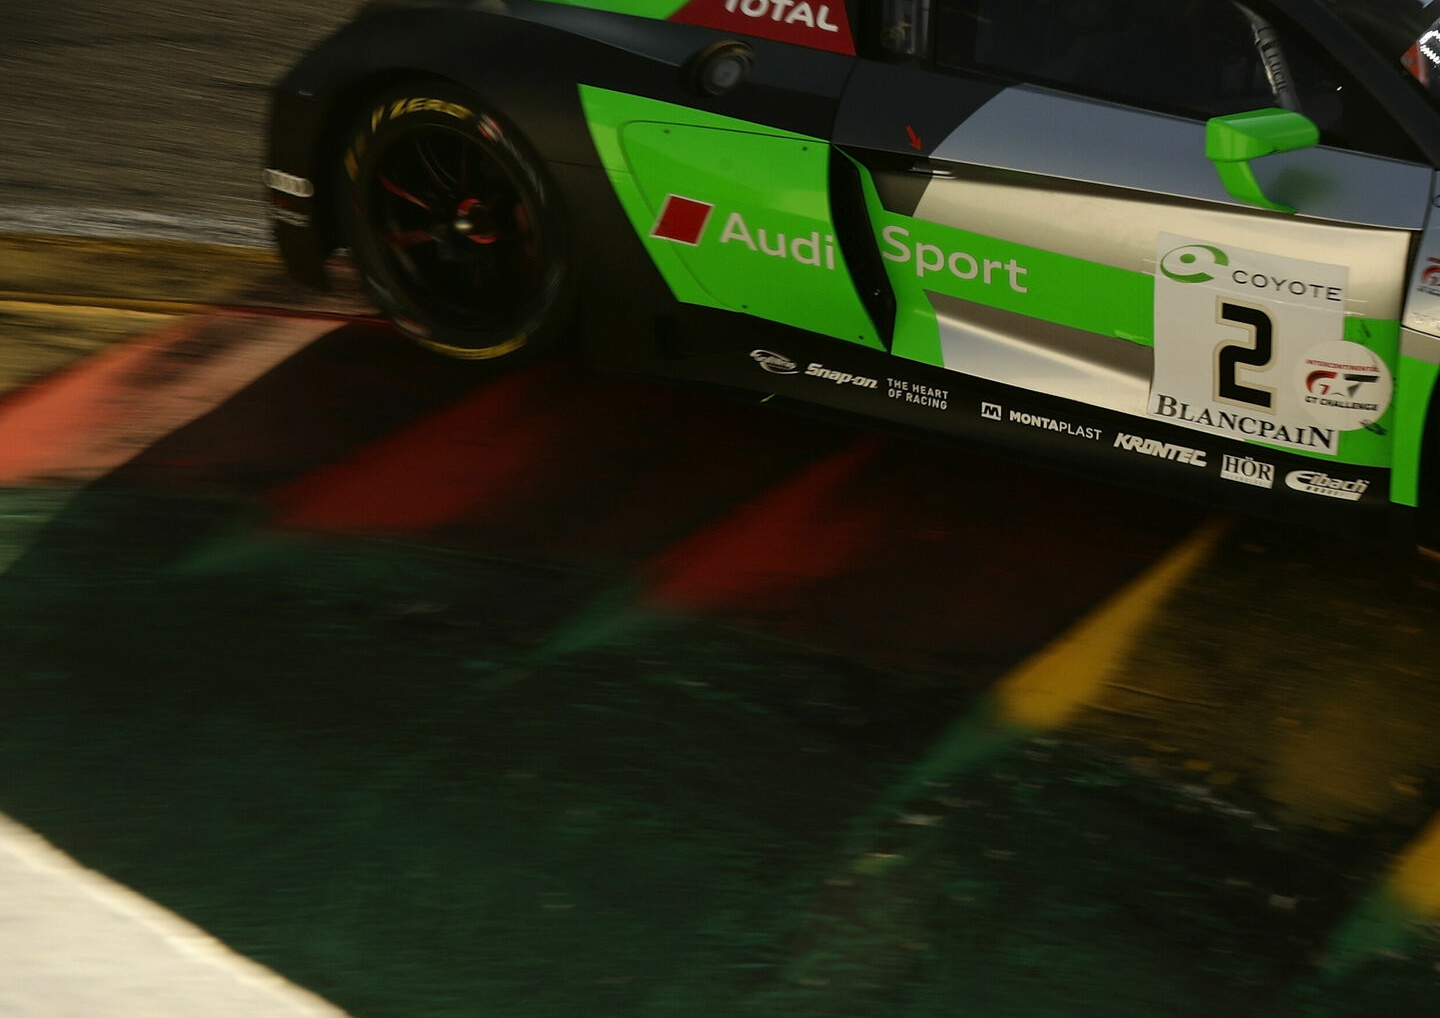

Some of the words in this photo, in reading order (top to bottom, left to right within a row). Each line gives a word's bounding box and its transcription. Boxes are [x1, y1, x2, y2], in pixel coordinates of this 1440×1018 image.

[719, 212, 835, 271] Audi
[882, 225, 1028, 294] Sport
[1232, 269, 1342, 302] COYOTE
[1217, 300, 1274, 411] 2
[804, 362, 879, 389] Snap-on
[886, 377, 909, 391] THE
[912, 384, 949, 400] HEART
[888, 388, 903, 400] OF
[906, 393, 948, 411] RACING
[1009, 409, 1102, 441] MONTAPLAST
[1154, 393, 1334, 449] BLANCPAIN
[1112, 432, 1208, 468] KRONTEC
[1225, 455, 1272, 481] HÖR
[1285, 469, 1371, 498] Eibach
